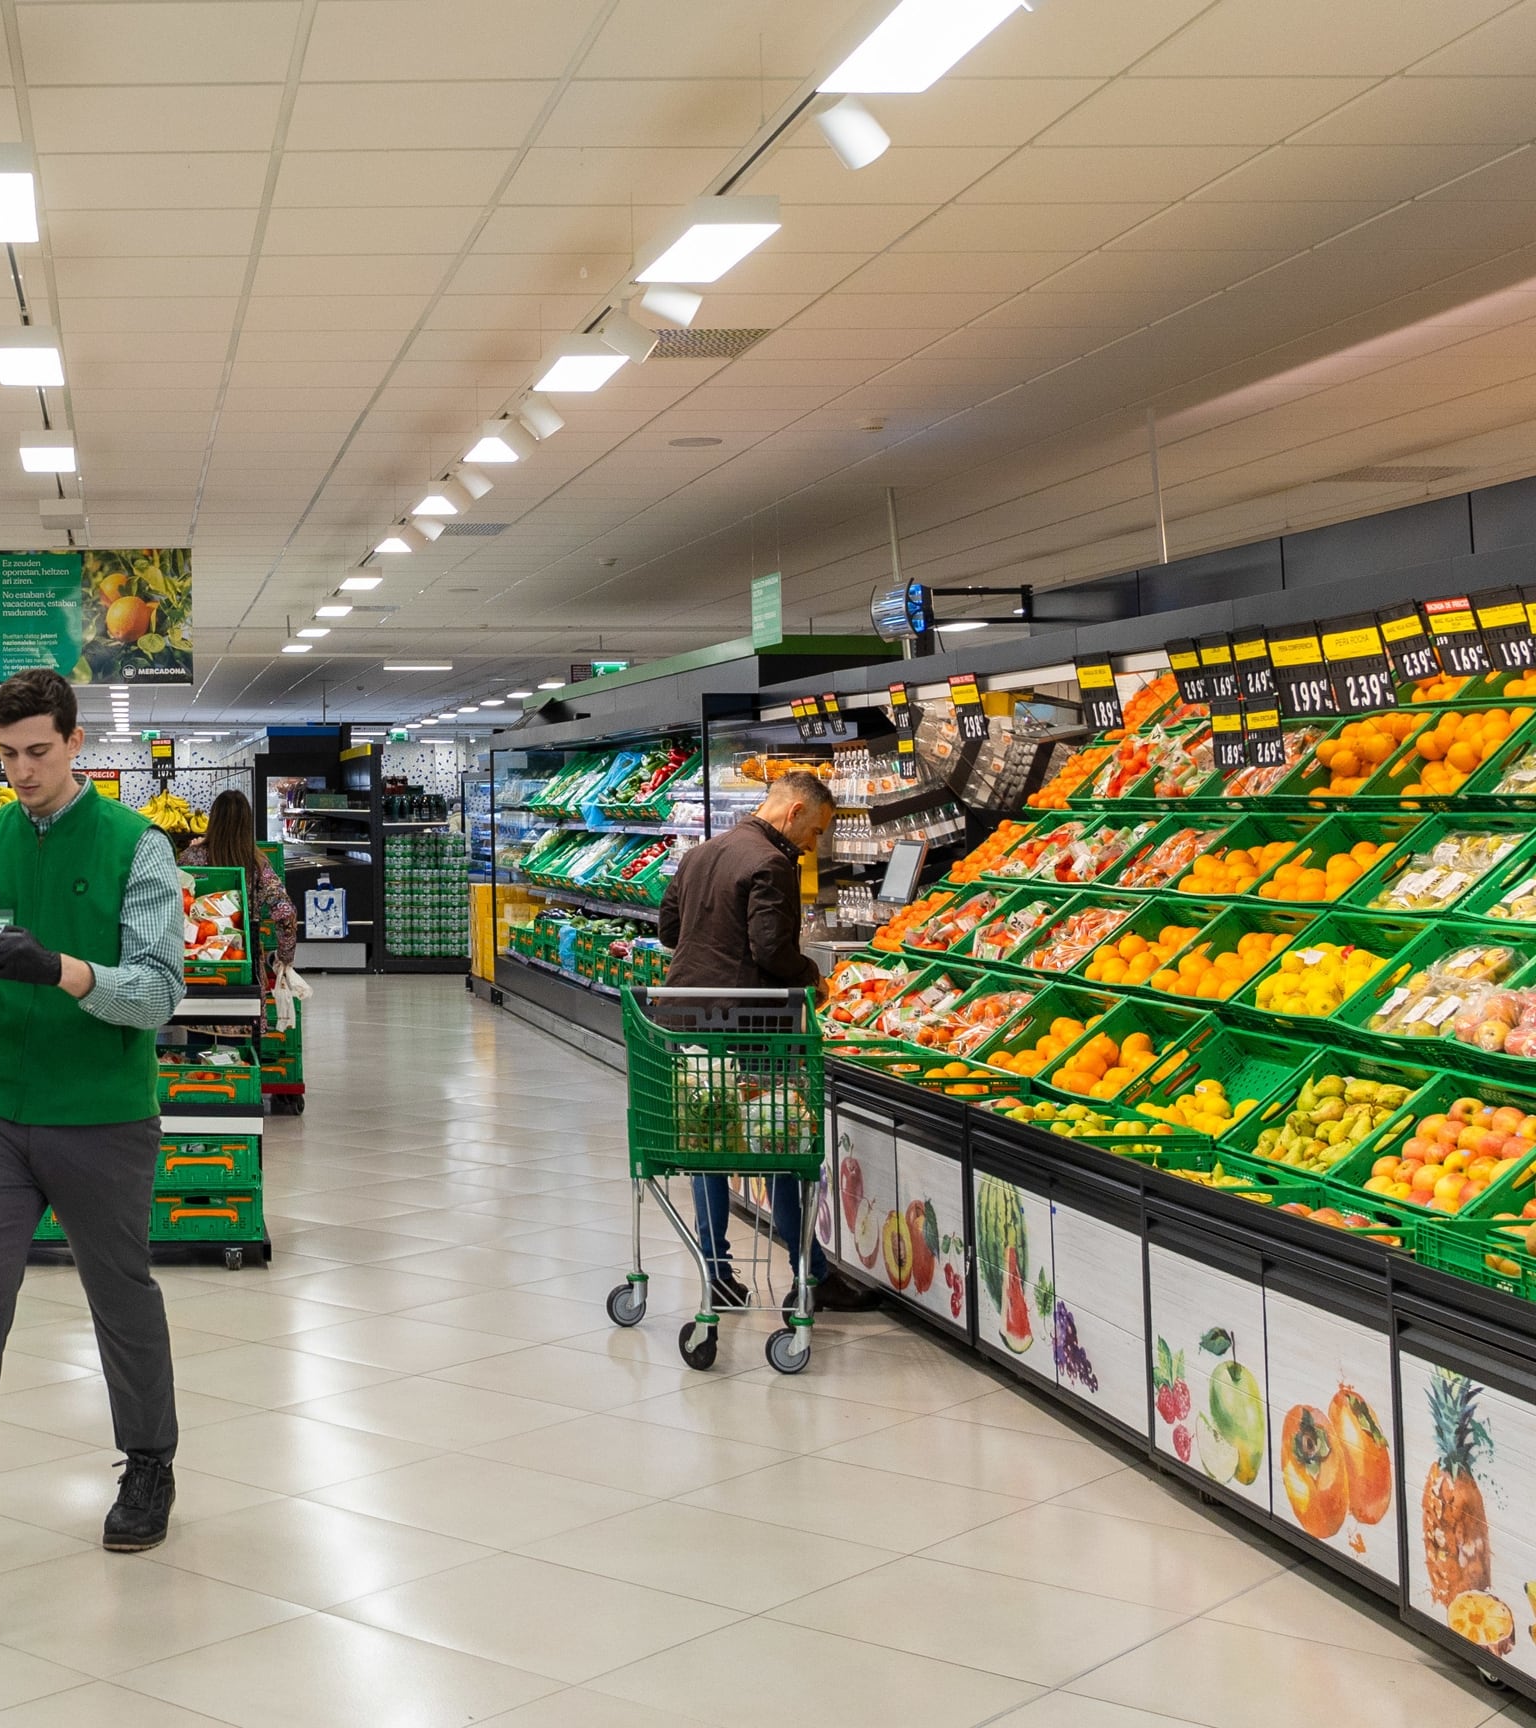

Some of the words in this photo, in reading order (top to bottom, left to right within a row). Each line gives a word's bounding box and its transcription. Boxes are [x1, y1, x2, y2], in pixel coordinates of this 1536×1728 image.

[42, 568, 69, 576] heltzen
[138, 667, 186, 675] MERCADONA
[88, 771, 115, 779] PRECIO
